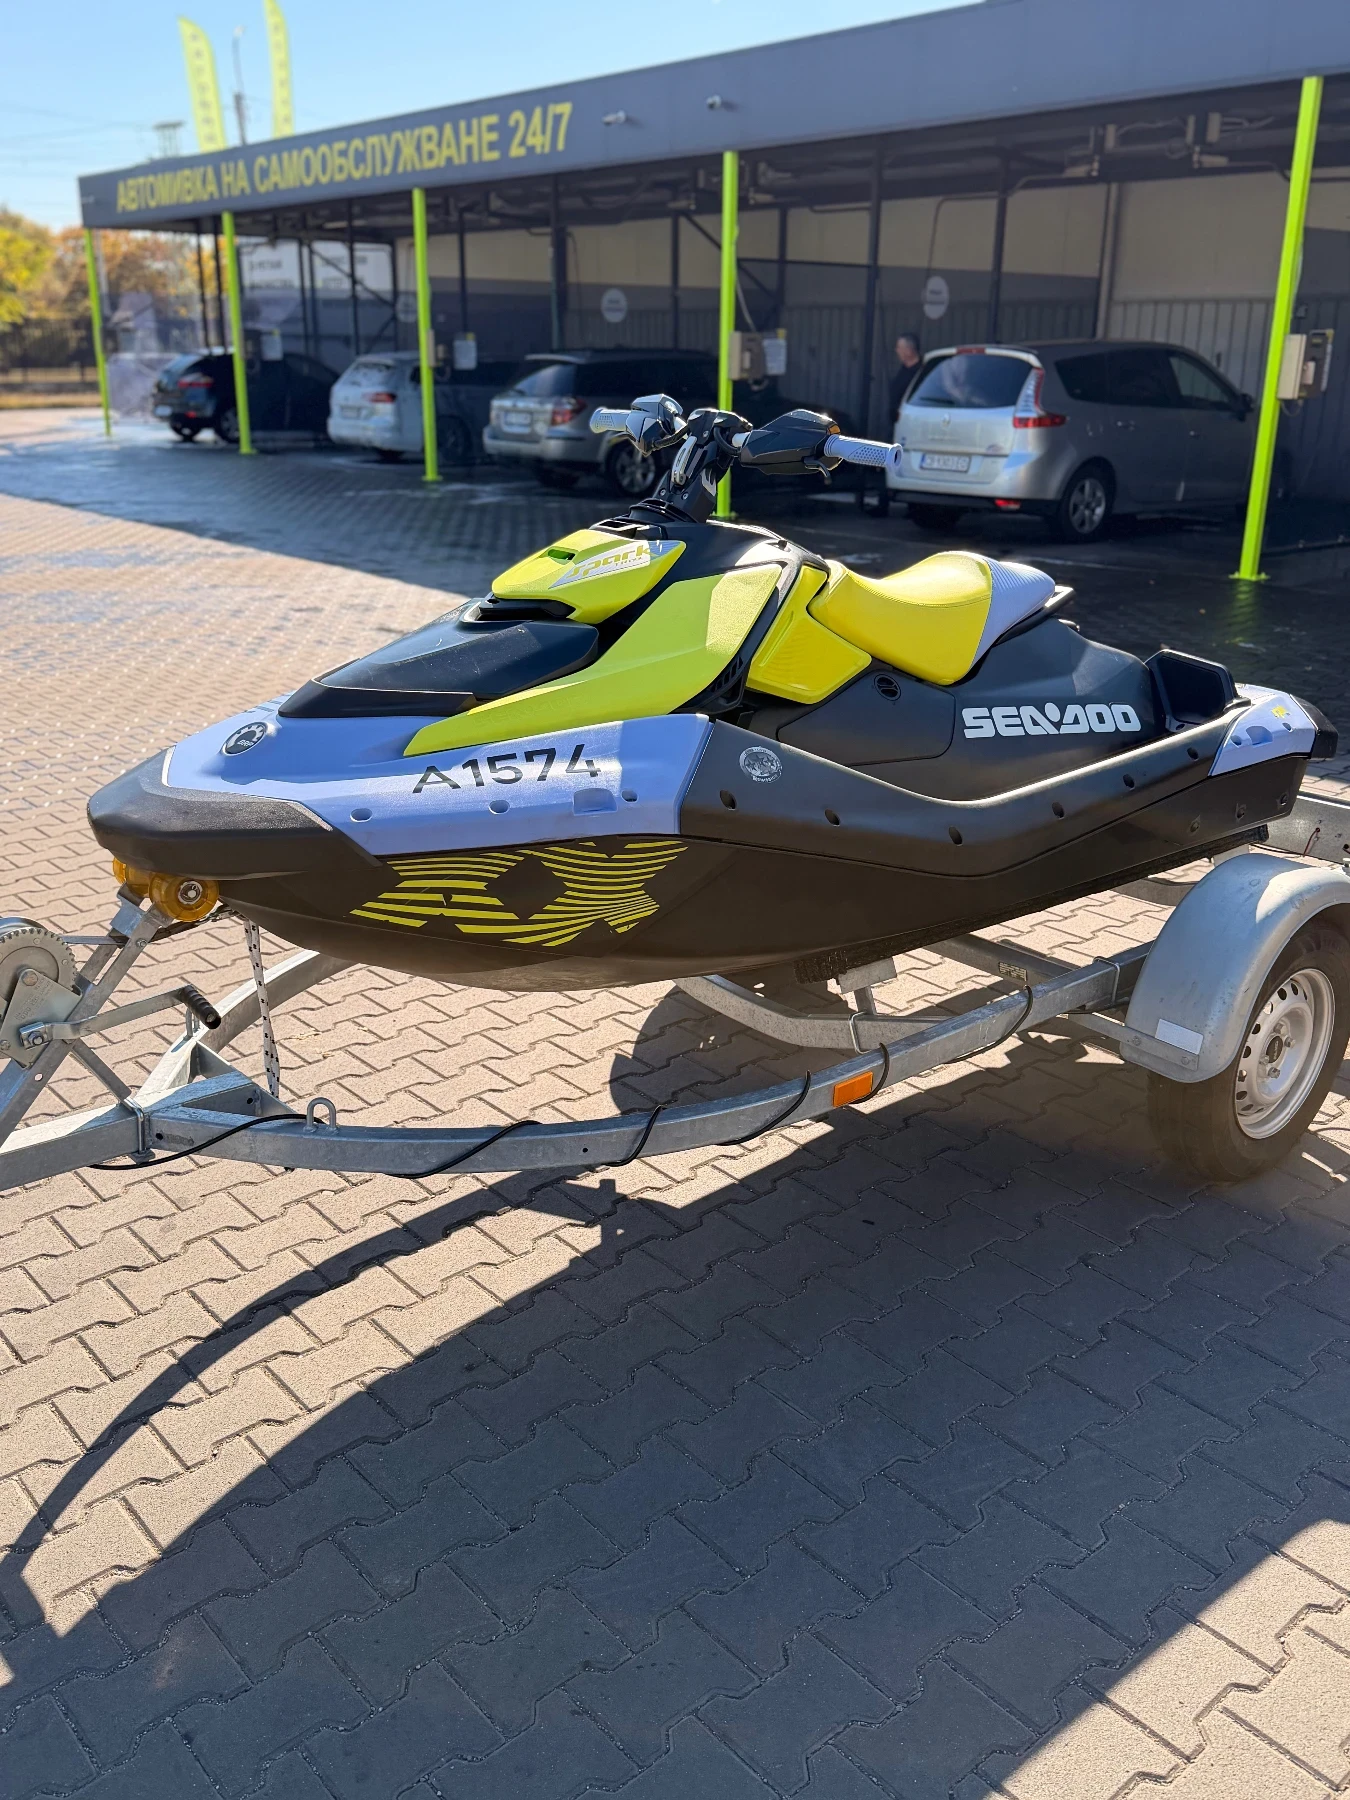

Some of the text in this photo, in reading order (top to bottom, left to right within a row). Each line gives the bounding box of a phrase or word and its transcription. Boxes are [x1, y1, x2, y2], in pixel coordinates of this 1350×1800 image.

[116, 102, 572, 213] АВТОМИВКА НА САМООБСЛУЖВАНЕ 24/7
[412, 743, 600, 794] A1574
